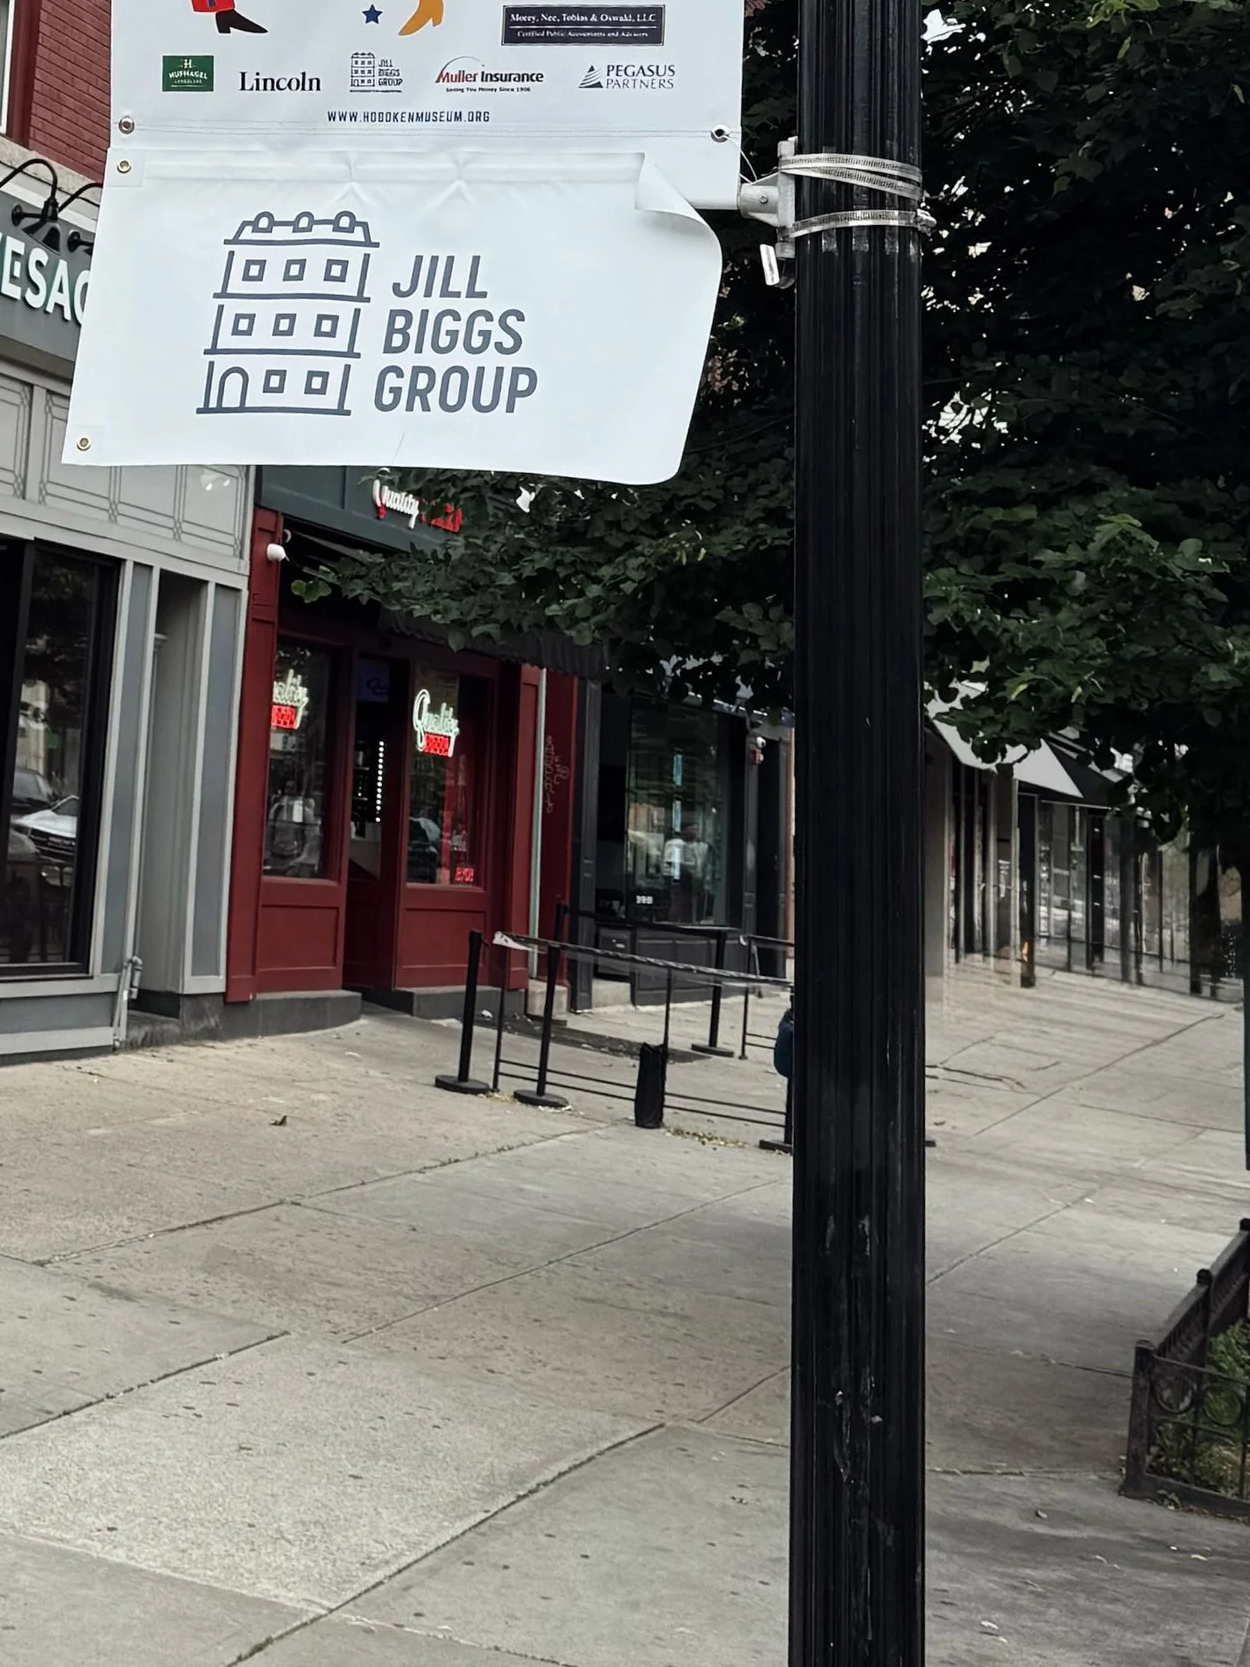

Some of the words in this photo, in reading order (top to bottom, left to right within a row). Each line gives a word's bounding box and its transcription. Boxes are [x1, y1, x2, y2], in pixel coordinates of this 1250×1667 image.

[562, 14, 588, 22] Tobias
[590, 14, 598, 22] &
[637, 14, 656, 22] LLC
[435, 70, 478, 83] Muller
[481, 70, 544, 83] Insurance
[606, 65, 676, 77] PEGASUS
[239, 72, 321, 91] Lincoln
[606, 78, 675, 89] PARTNERS
[327, 111, 491, 123] WWW.HOBOKENMUSEUM.ORG
[391, 254, 489, 300] JILL
[382, 308, 525, 356] BIGGS
[372, 364, 538, 415] GROUP
[413, 689, 459, 758] Quality
